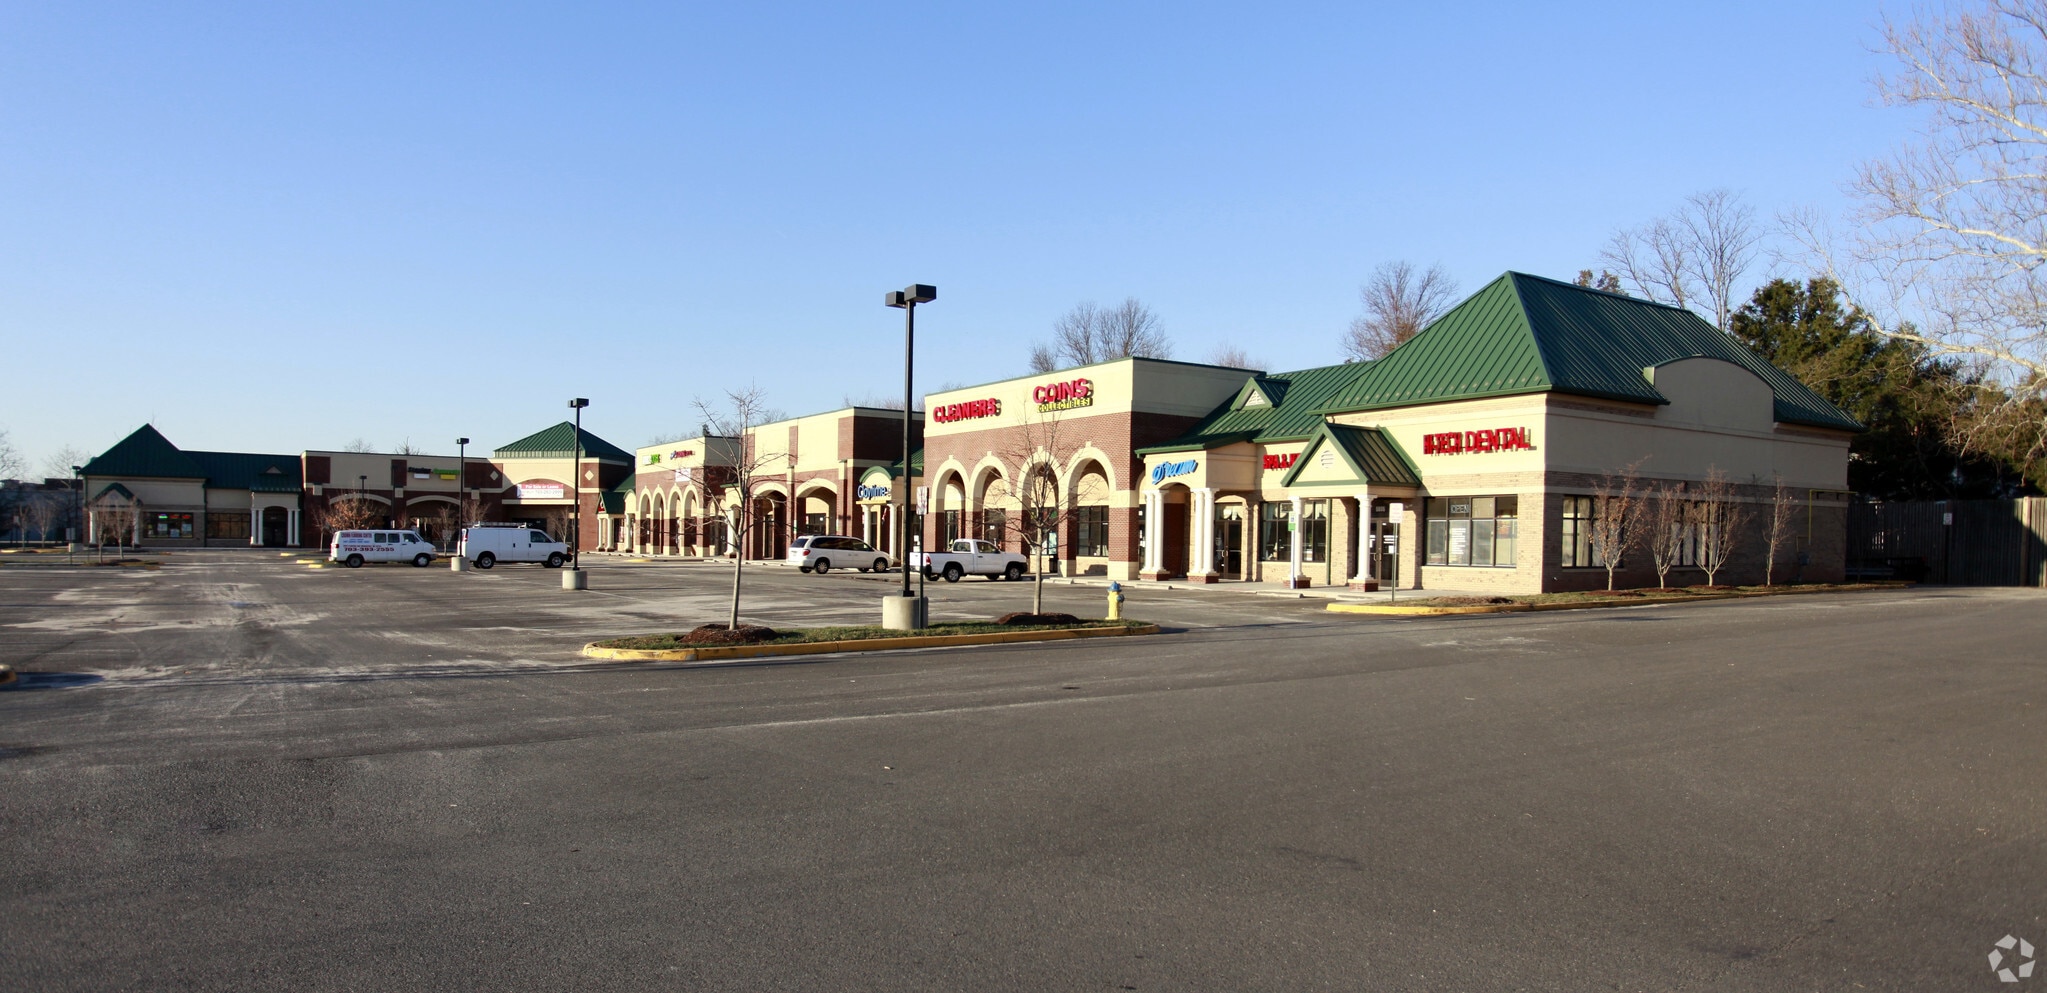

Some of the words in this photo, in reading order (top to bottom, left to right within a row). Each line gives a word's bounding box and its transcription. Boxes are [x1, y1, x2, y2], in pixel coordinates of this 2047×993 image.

[1033, 378, 1090, 403] COINS
[933, 397, 999, 423] CLEANERS
[1038, 398, 1090, 412] COLLECTIBLES
[1423, 431, 1463, 455] HI-TECH
[1465, 426, 1532, 452] DENTAL
[1262, 454, 1279, 470] SPA
[1281, 453, 1290, 469] &
[1450, 504, 1469, 513] OPEN
